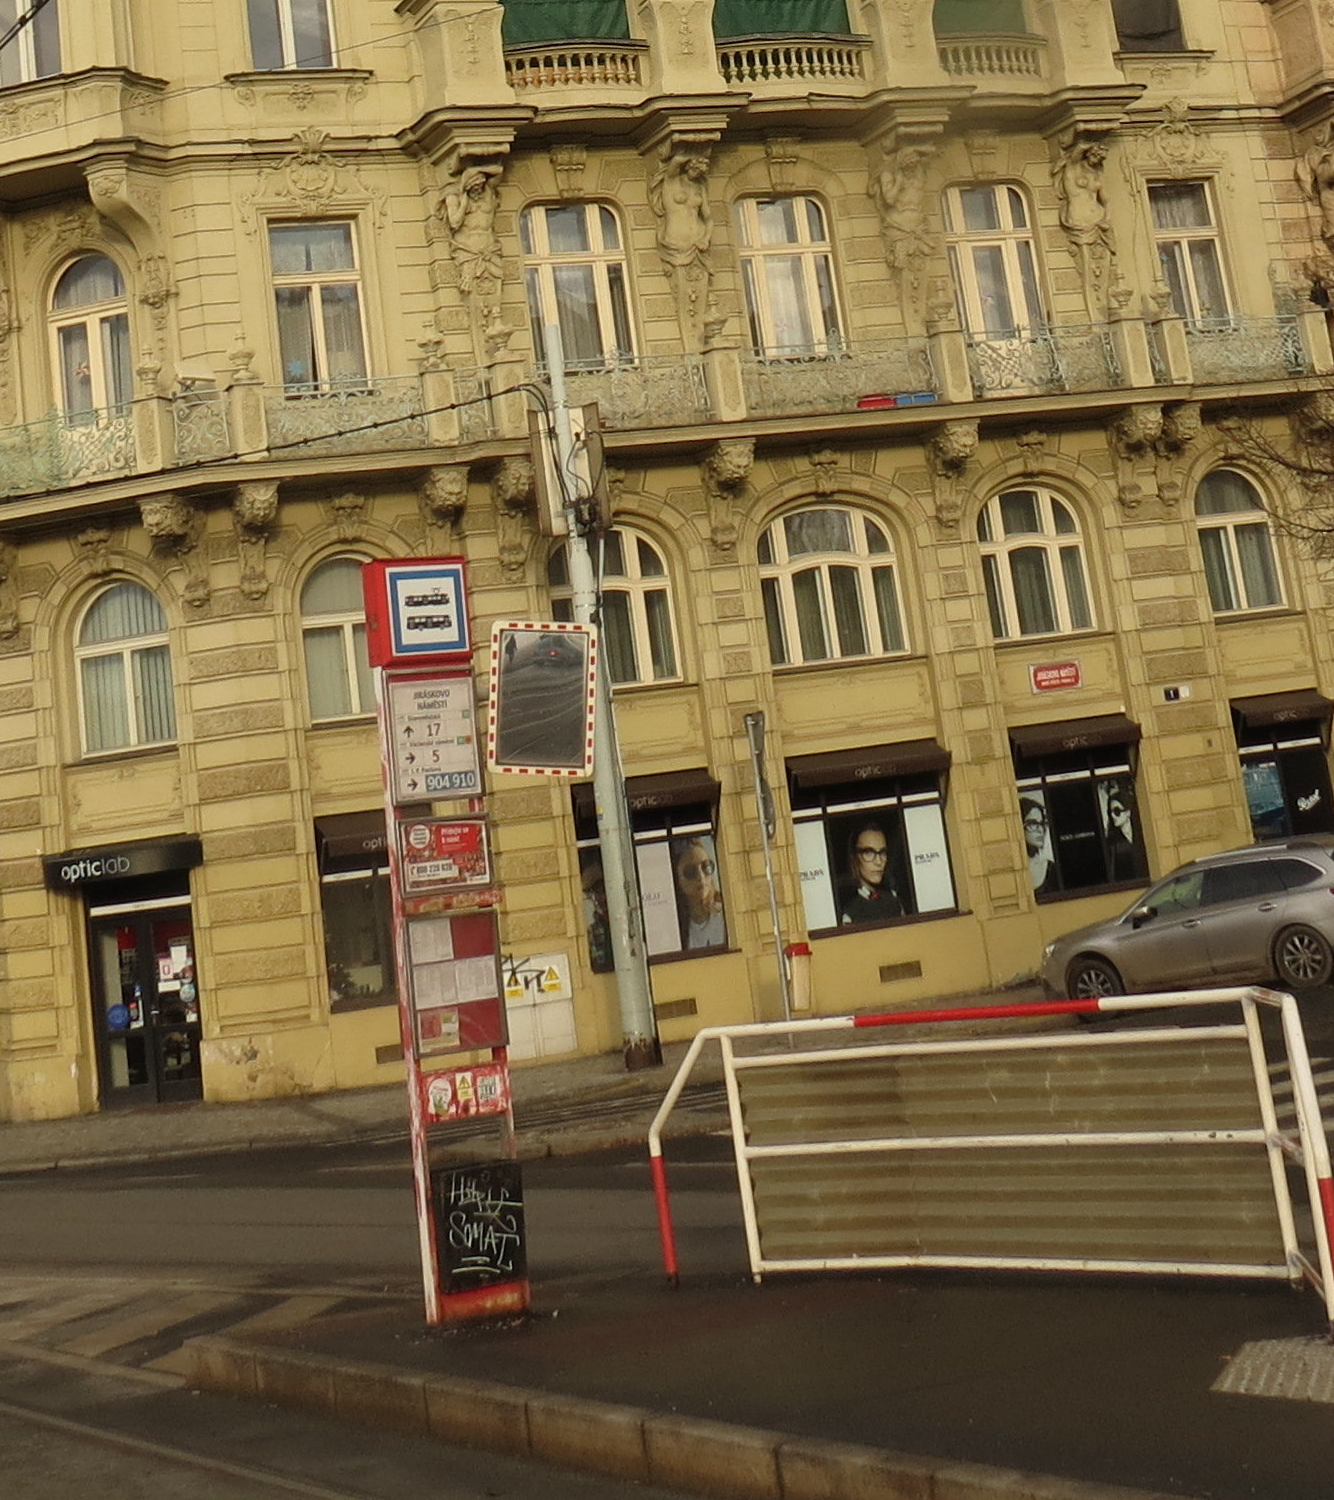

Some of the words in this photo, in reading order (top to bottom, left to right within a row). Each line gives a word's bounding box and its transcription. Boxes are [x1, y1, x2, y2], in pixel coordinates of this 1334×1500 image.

[427, 722, 441, 737] 17
[432, 749, 440, 763] 5
[427, 774, 450, 790] 904
[452, 772, 475, 788] 910
[61, 856, 131, 883] opticlab
